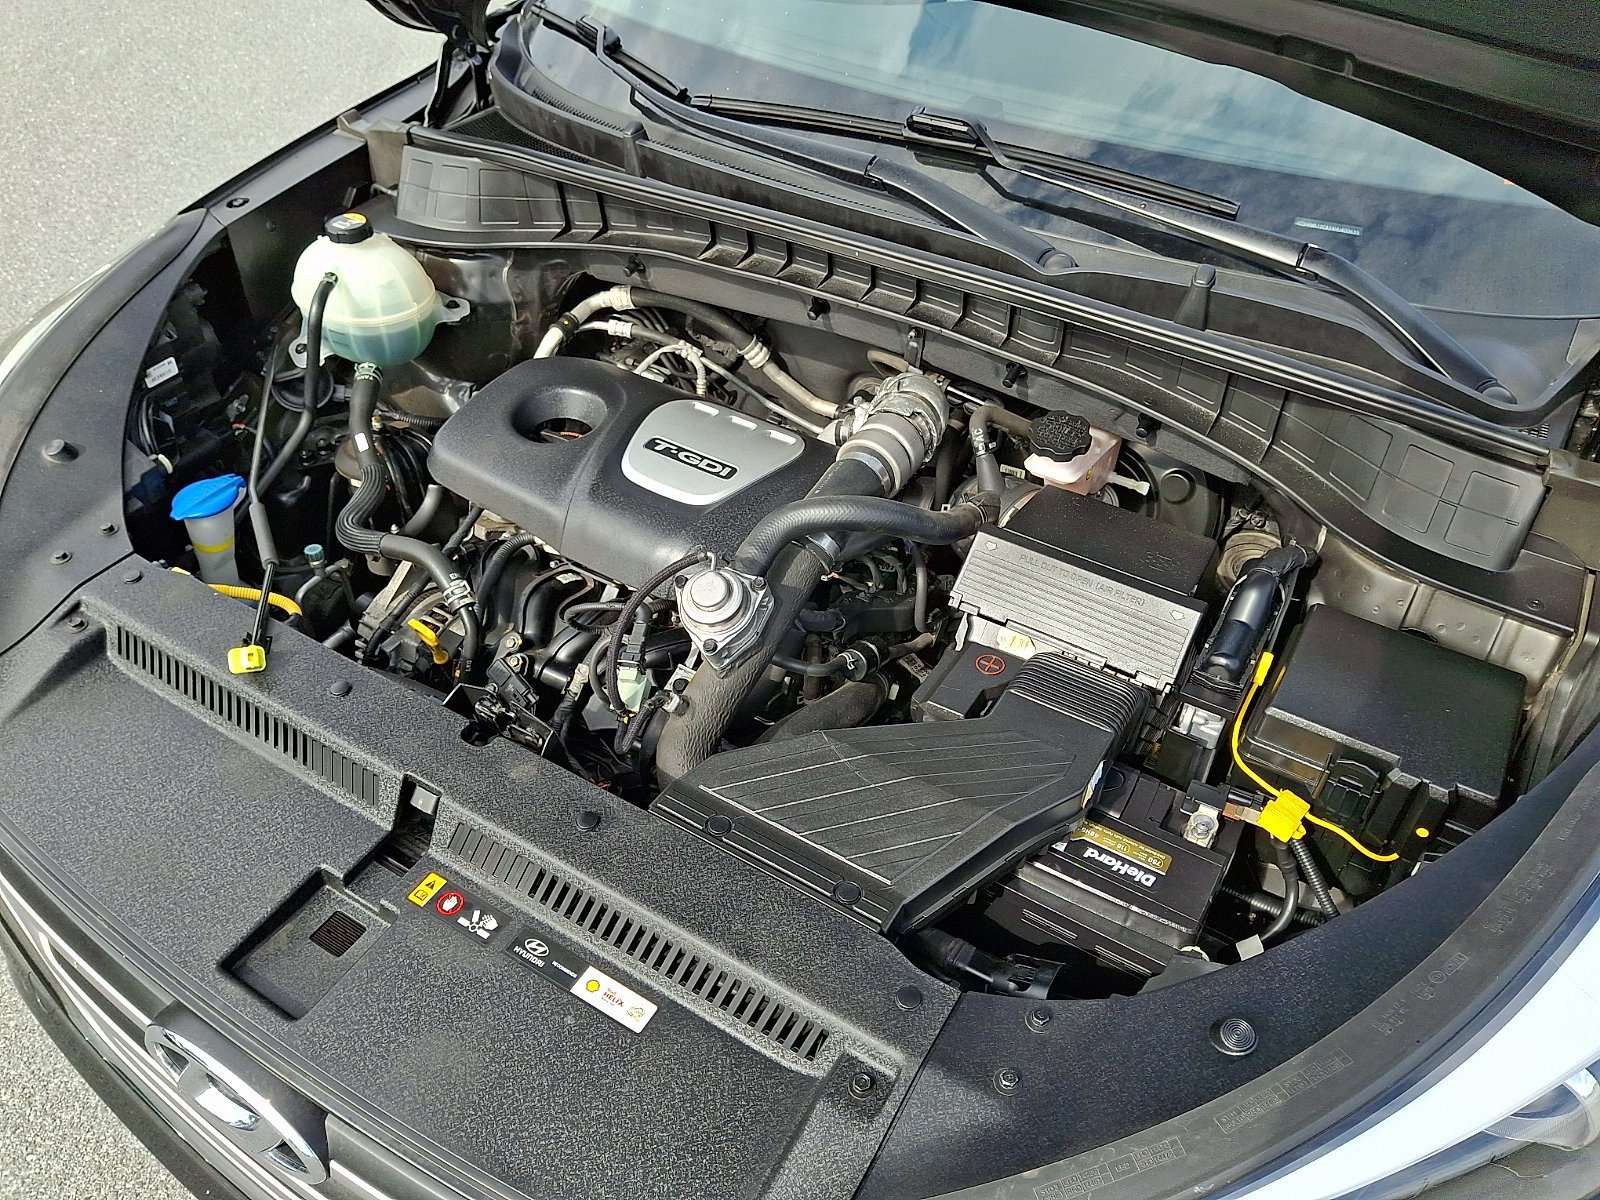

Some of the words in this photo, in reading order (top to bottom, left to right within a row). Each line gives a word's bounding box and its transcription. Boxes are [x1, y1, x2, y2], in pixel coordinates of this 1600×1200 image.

[1020, 554, 1039, 567] PULL
[1041, 561, 1058, 573] OUT
[1058, 567, 1070, 578] TO
[1071, 572, 1094, 588] OPEN
[1095, 582, 1114, 595] (AIR
[1114, 589, 1146, 607] FILTER)
[1082, 846, 1157, 888] DieHard
[513, 945, 545, 968] HYUNDAI
[603, 991, 625, 1007] HELIX
